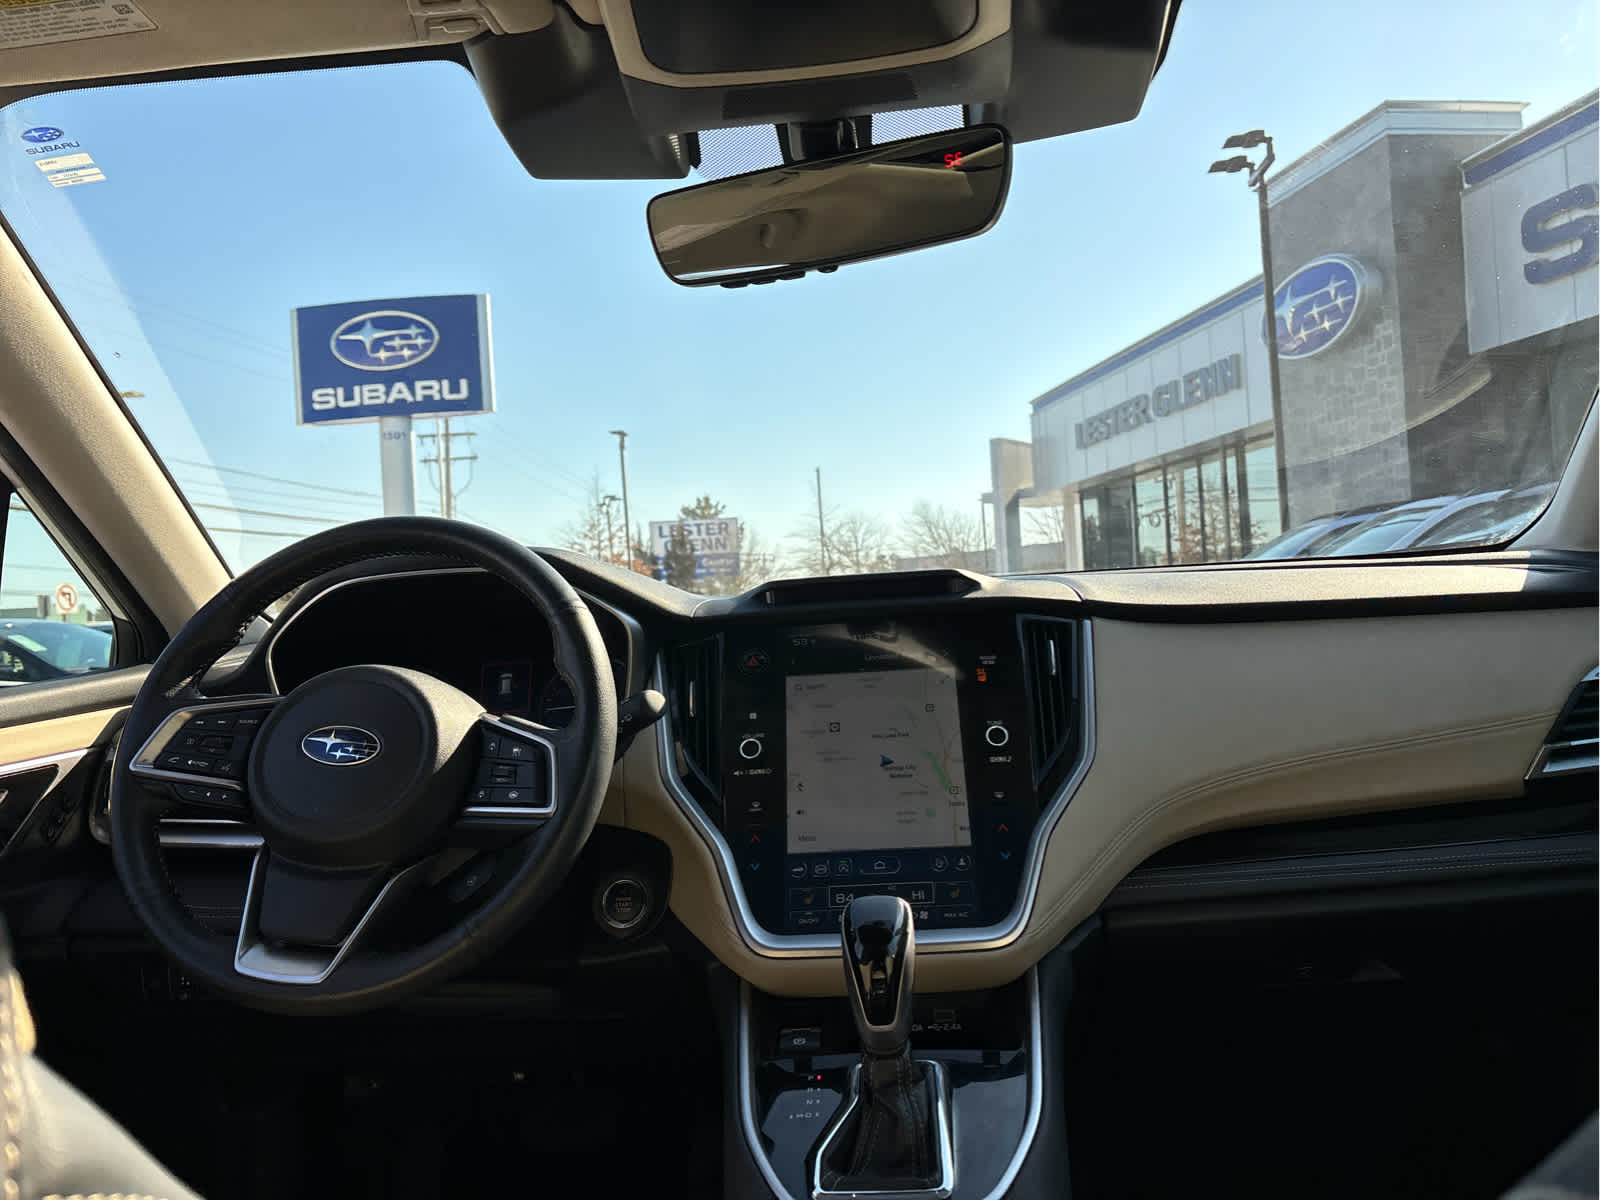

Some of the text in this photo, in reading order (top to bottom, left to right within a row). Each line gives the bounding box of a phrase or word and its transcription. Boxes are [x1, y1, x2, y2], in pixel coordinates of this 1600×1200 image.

[26, 141, 80, 155] SUBARU
[943, 152, 963, 168] SE
[1520, 183, 1600, 285] S
[311, 378, 469, 411] SUBARU
[1074, 353, 1241, 450] LESTER GLENN
